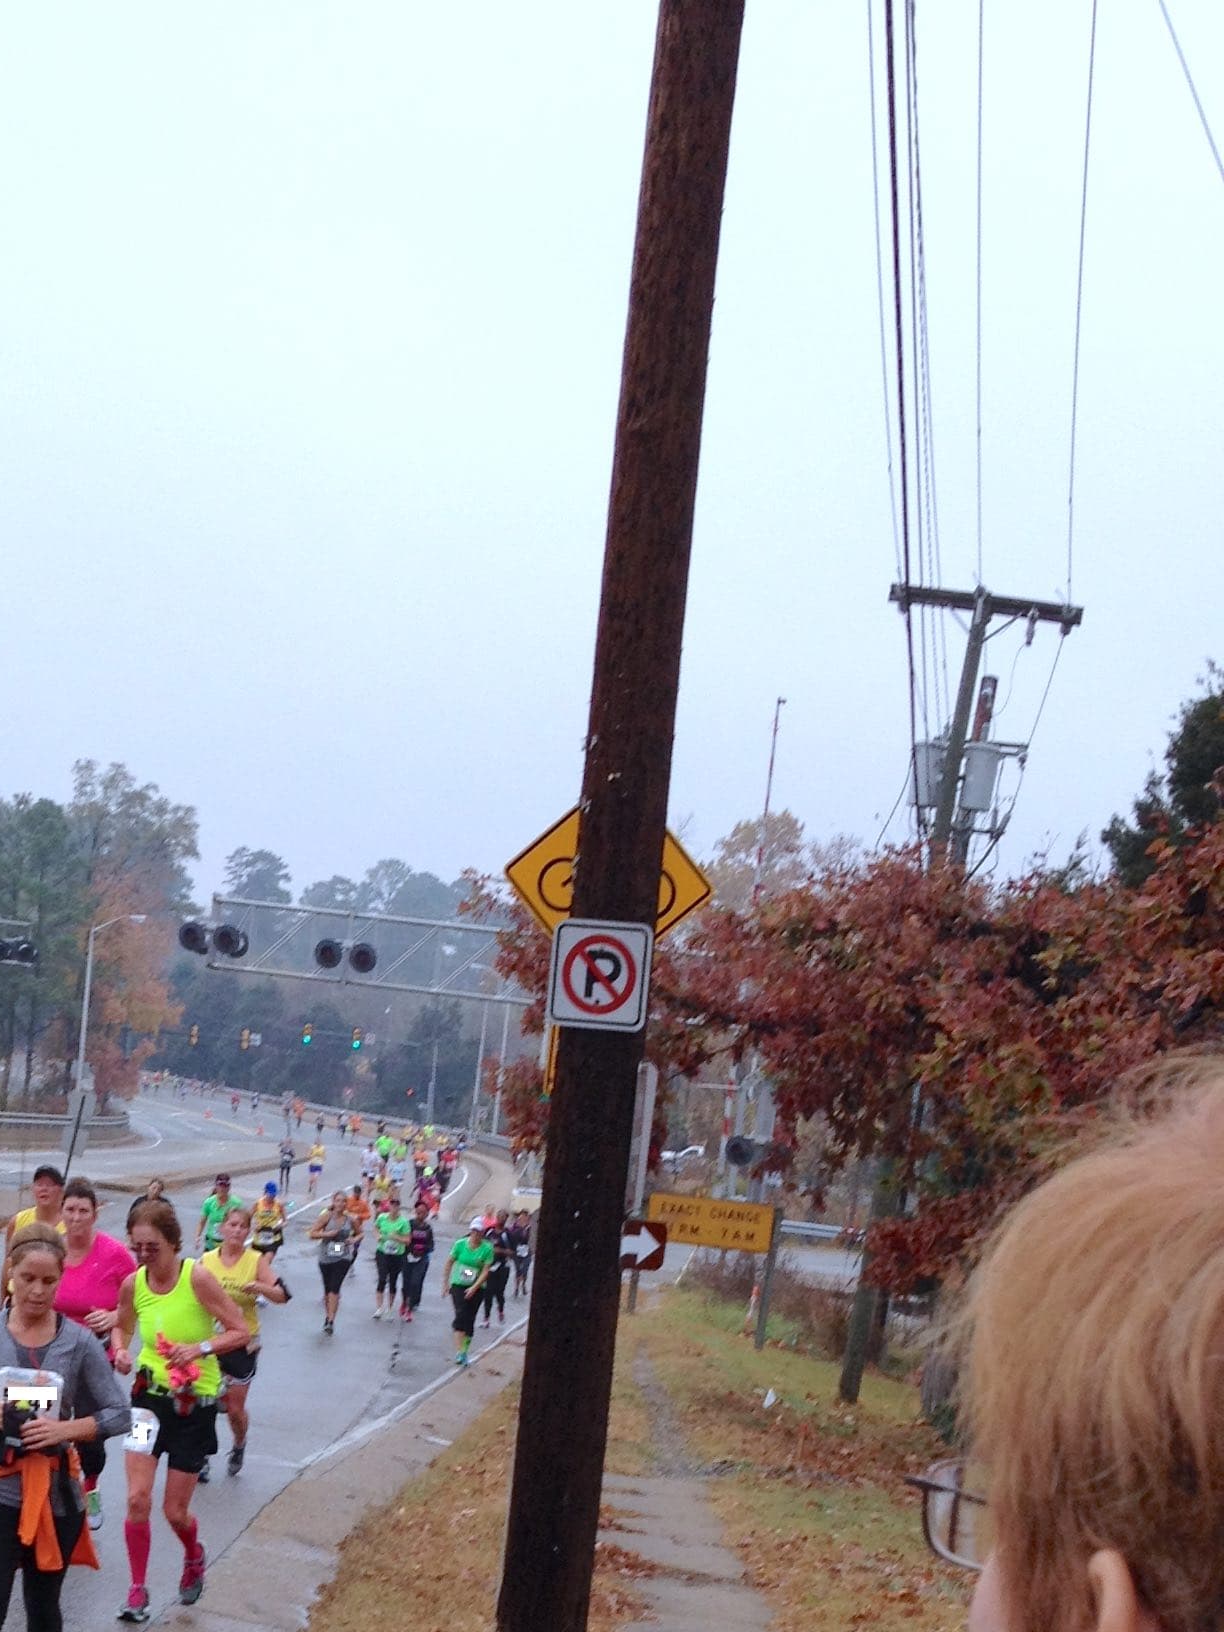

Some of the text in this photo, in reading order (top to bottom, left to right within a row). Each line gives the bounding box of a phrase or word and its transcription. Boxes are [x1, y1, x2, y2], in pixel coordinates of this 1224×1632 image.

[584, 949, 622, 998] P
[660, 1201, 761, 1224] EXACT CHANGE
[679, 1223, 700, 1236] PM
